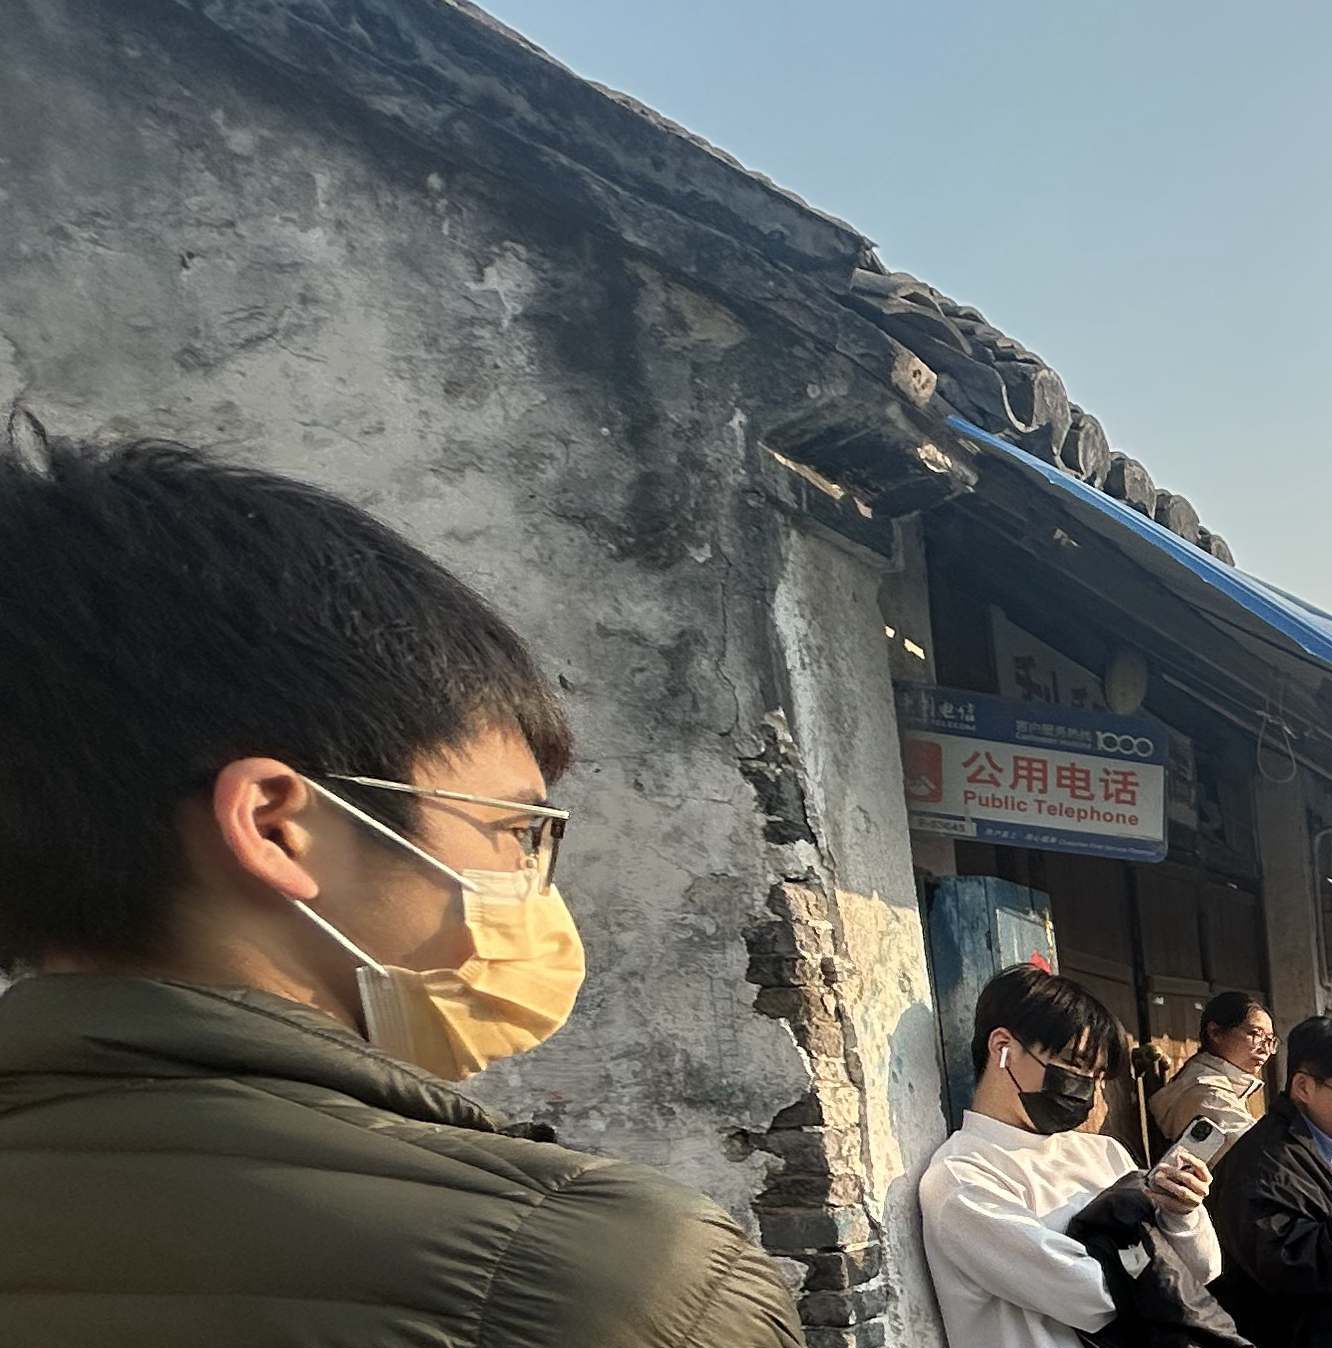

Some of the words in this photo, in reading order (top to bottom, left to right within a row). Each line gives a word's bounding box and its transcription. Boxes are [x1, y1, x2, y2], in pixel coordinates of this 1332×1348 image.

[962, 751, 1140, 807] 公用电话
[963, 791, 1028, 813] Public
[1033, 799, 1139, 826] Telephone
